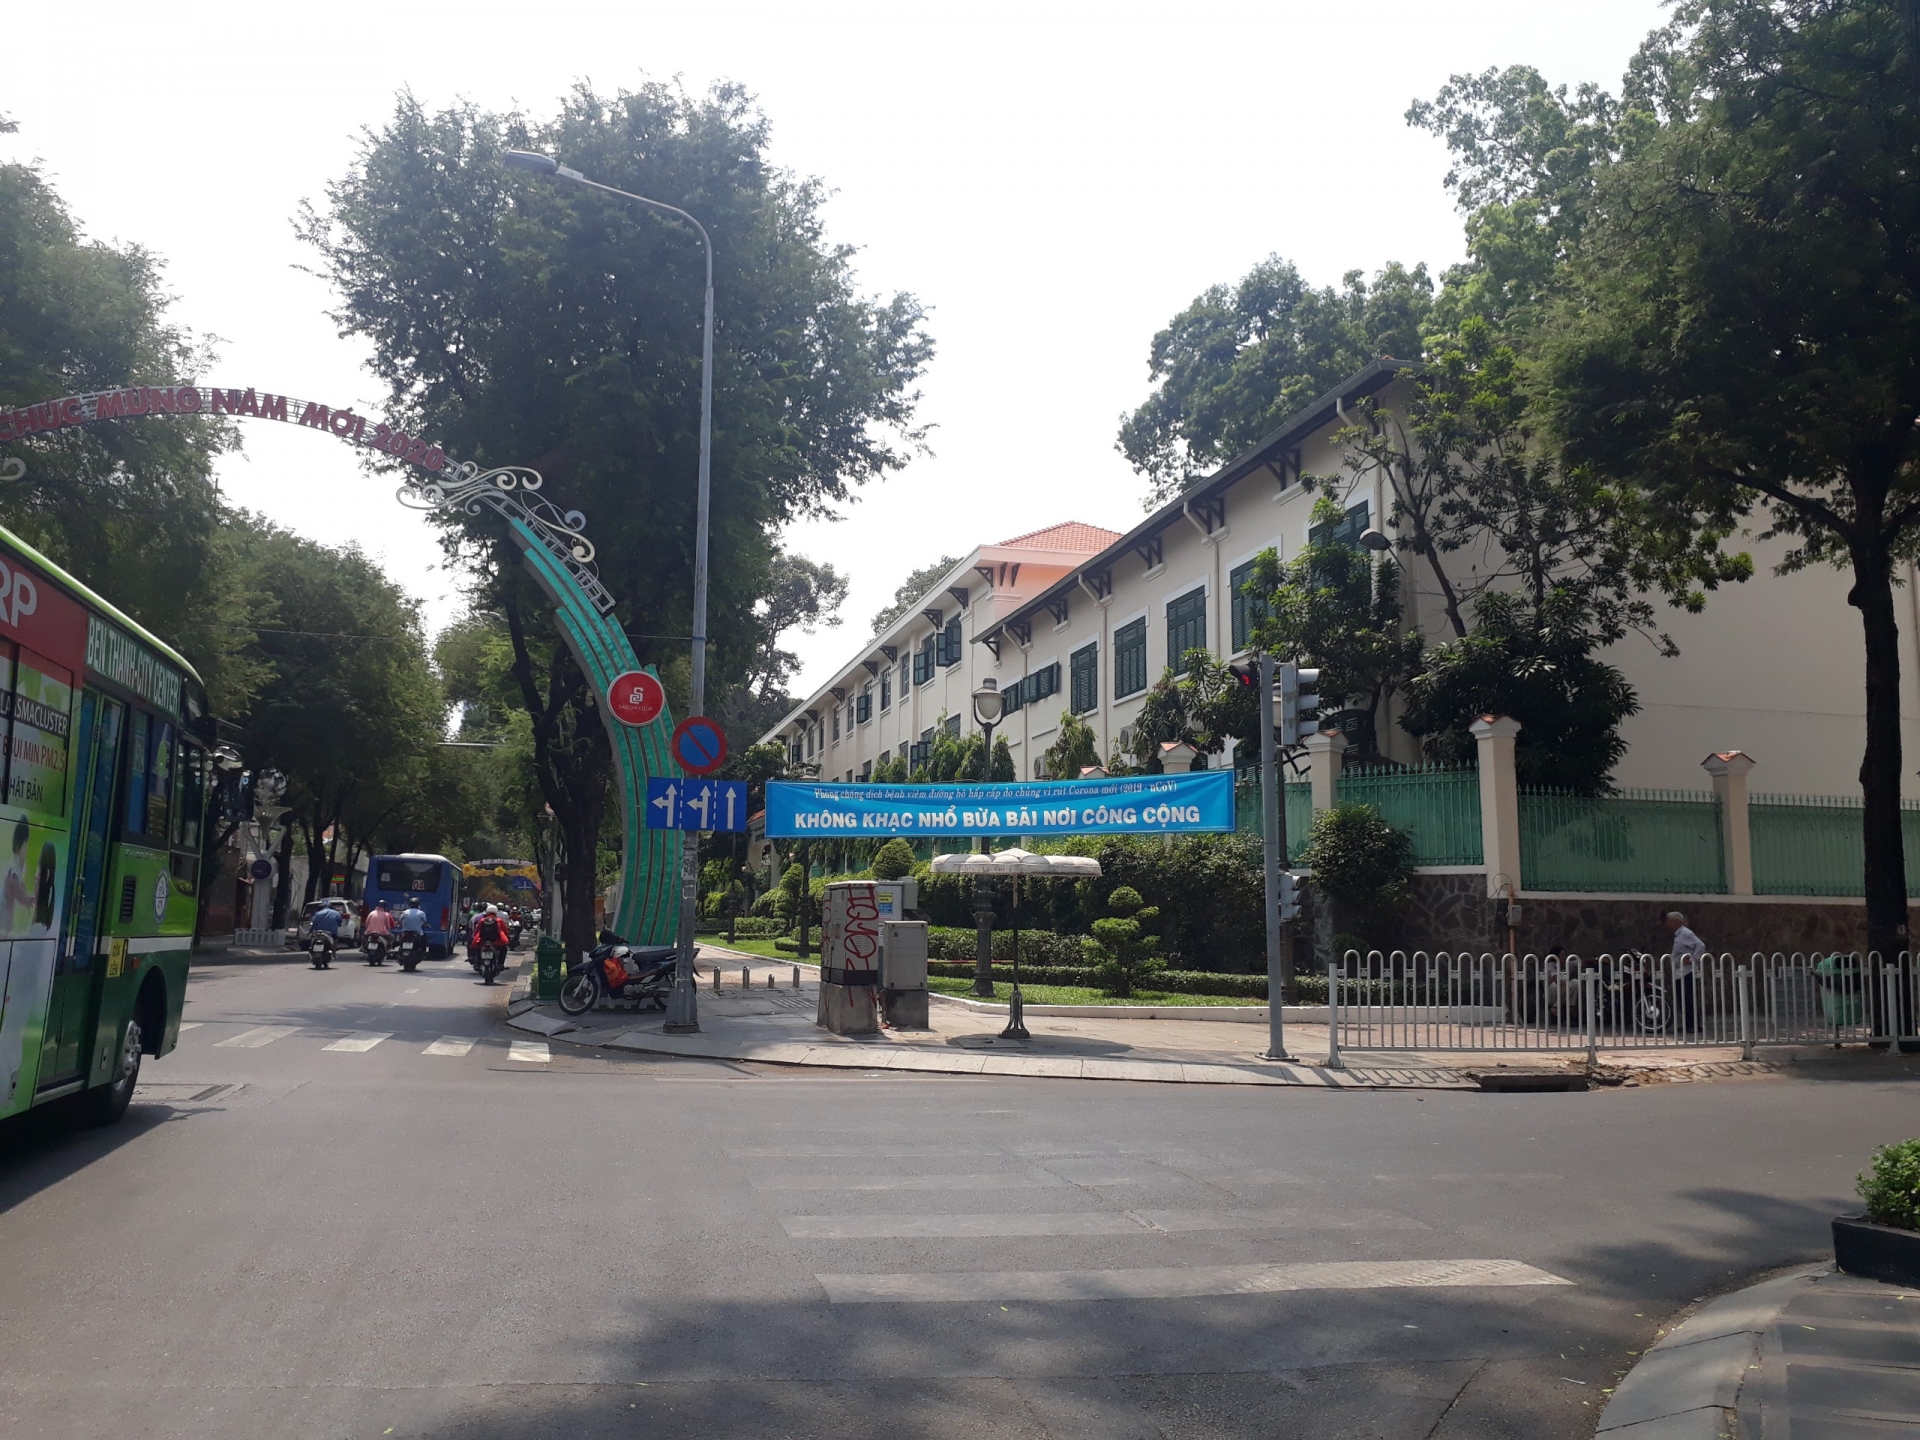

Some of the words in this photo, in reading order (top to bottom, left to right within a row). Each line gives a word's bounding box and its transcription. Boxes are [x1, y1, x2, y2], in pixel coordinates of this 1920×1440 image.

[96, 382, 200, 419] MỪNG
[212, 386, 287, 422] NĂM
[298, 401, 367, 440] MỚI
[367, 422, 445, 472] 2020
[88, 616, 107, 672] BEN
[153, 661, 179, 716] CENTER
[40, 745, 65, 773] PM2.5
[27, 778, 43, 802] BẢN
[841, 788, 864, 801] chống
[907, 788, 927, 799] viêm
[1003, 787, 1013, 797] do
[1053, 785, 1066, 796] rút
[1069, 785, 1099, 795] Corona
[1101, 783, 1118, 794] mới
[795, 809, 857, 829] KHÔNG
[862, 812, 913, 832] KHẠC
[918, 804, 957, 828] NHỔ
[963, 807, 1001, 828] BỪA
[1006, 807, 1037, 827] BÃI
[1043, 807, 1077, 826] NƠI
[1082, 805, 1137, 825] CÔNG
[1142, 803, 1200, 828] CỘNG
